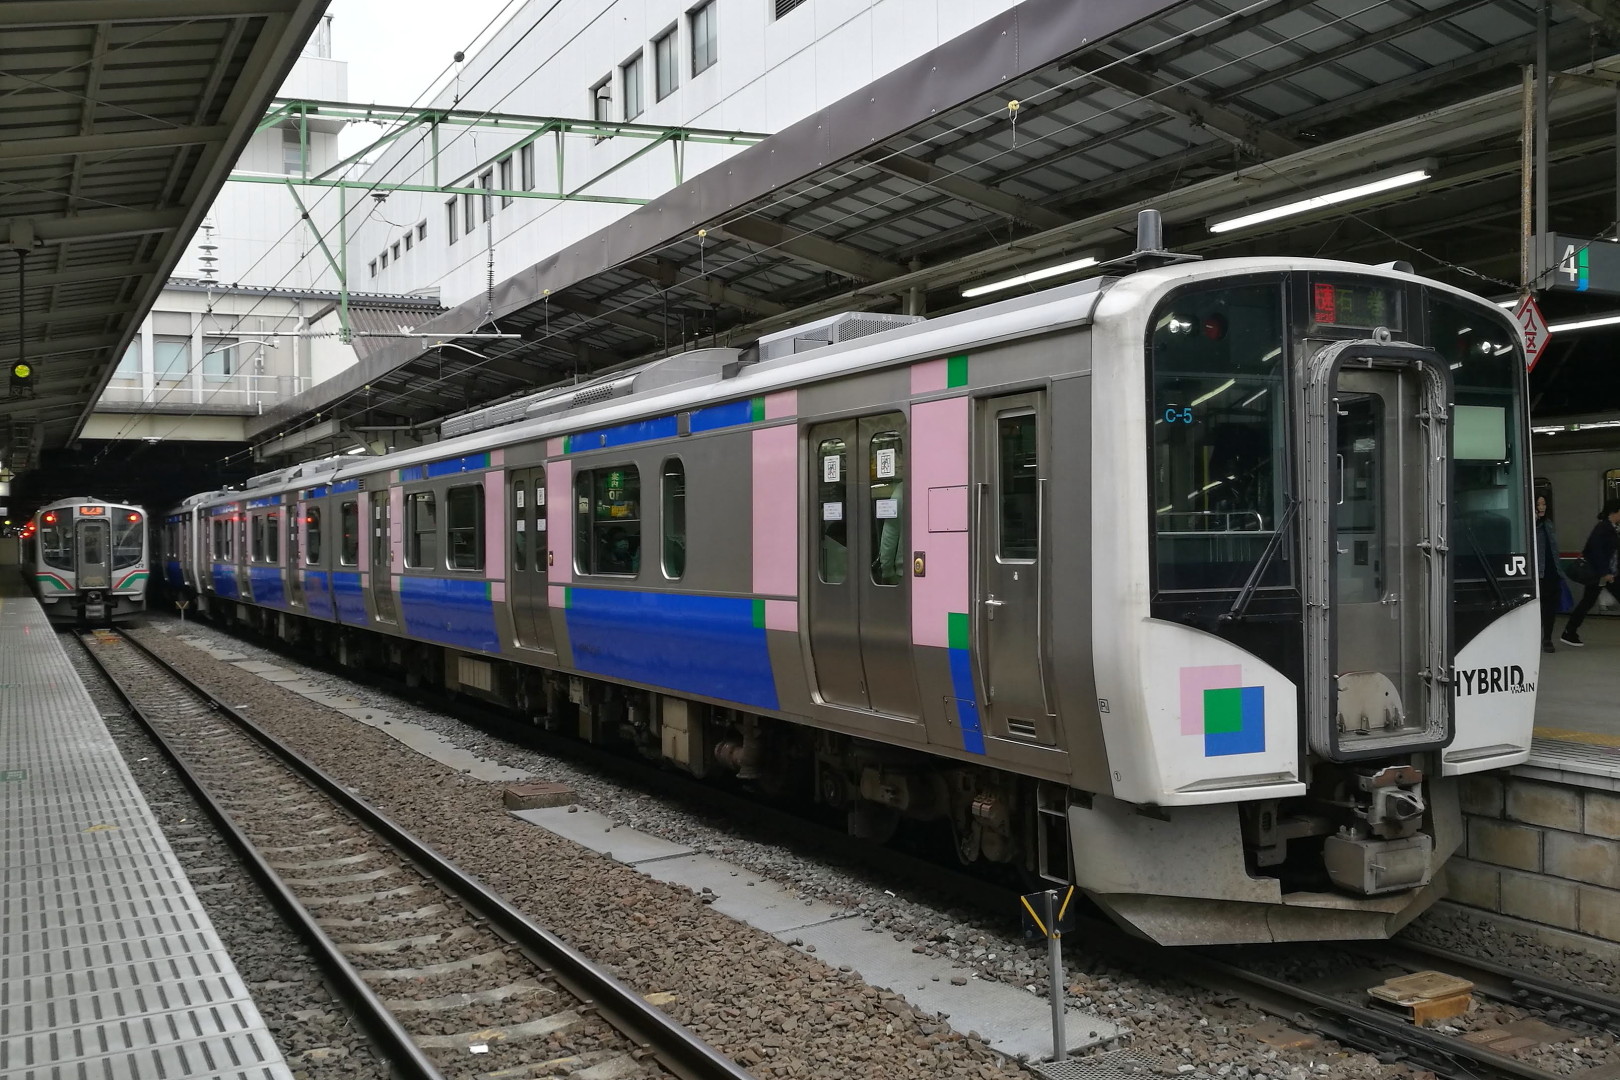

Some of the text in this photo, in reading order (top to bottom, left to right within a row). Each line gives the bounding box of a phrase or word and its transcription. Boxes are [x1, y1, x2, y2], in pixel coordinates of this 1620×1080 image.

[1558, 244, 1578, 282] 4
[1524, 308, 1537, 354] 入区
[1165, 407, 1193, 424] C-5
[1505, 555, 1527, 577] JR
[1454, 665, 1524, 697] HYBRID
